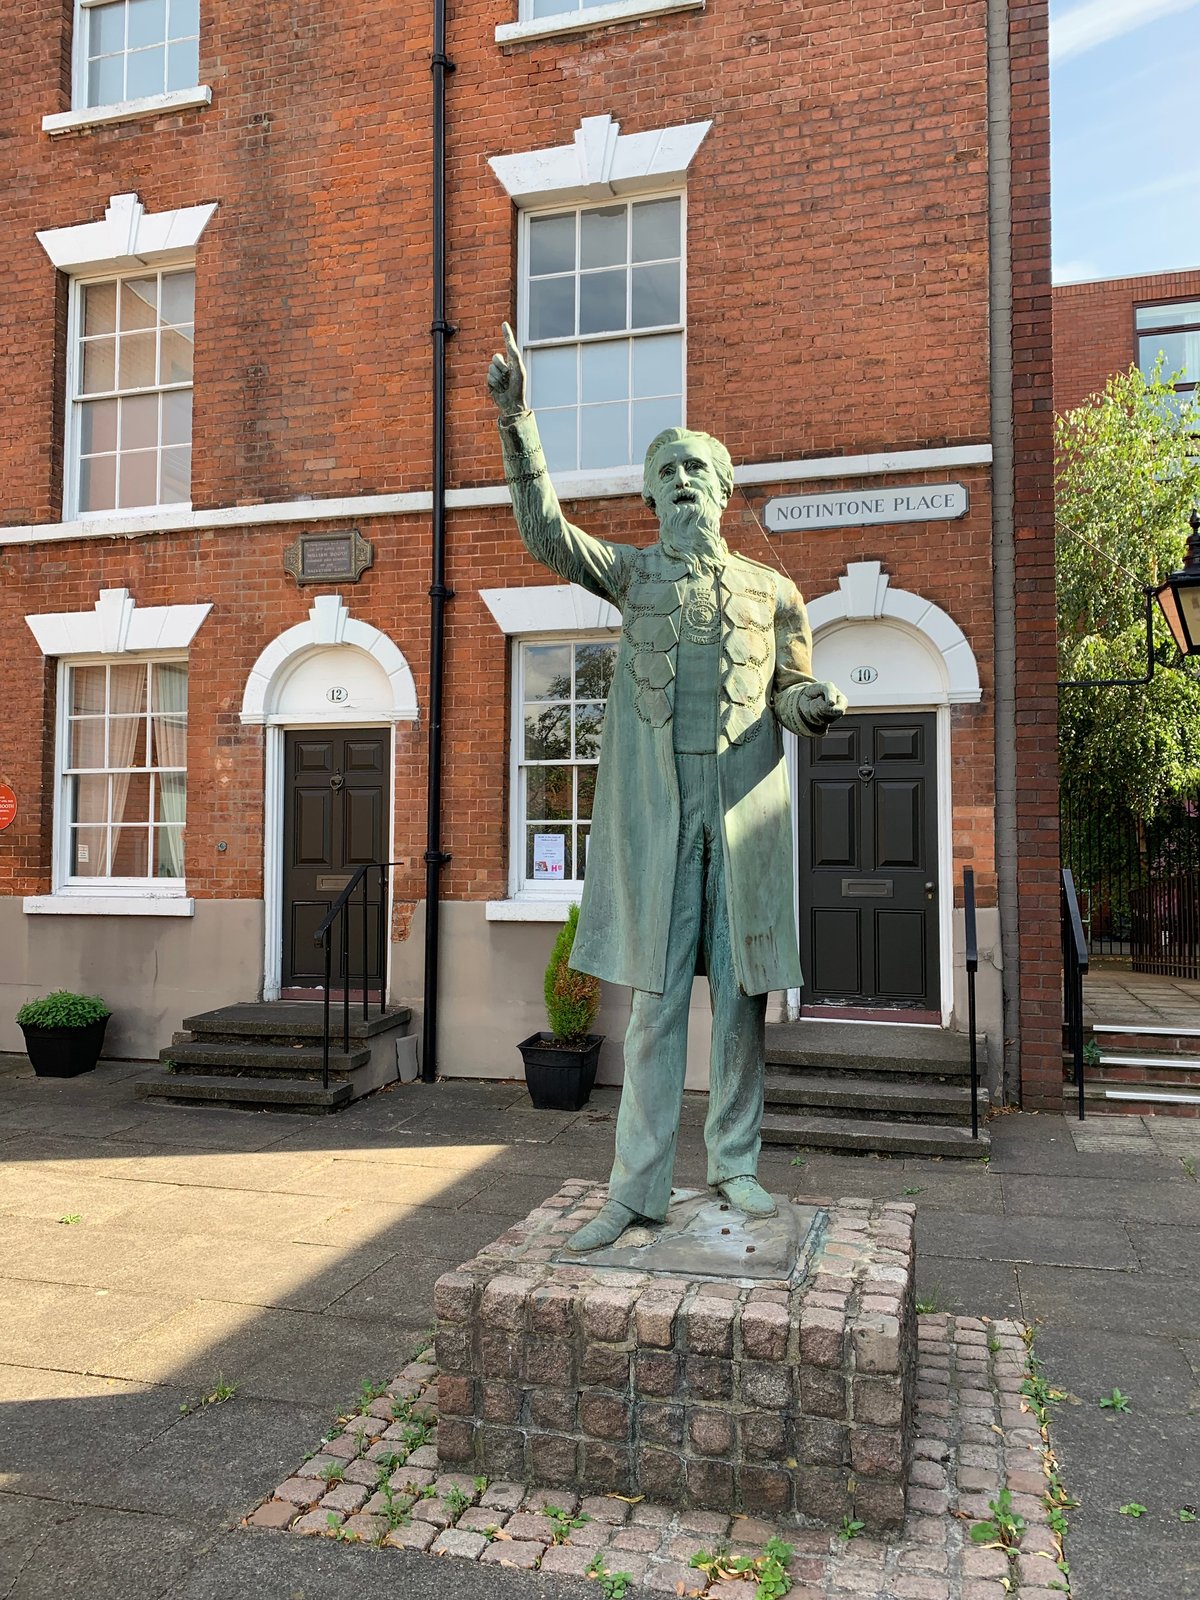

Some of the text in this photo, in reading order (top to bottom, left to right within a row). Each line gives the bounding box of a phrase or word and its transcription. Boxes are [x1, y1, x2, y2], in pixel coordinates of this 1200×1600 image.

[777, 493, 955, 521] NOTINTONE PLACE
[858, 669, 871, 682] 10
[331, 689, 342, 701] 12
